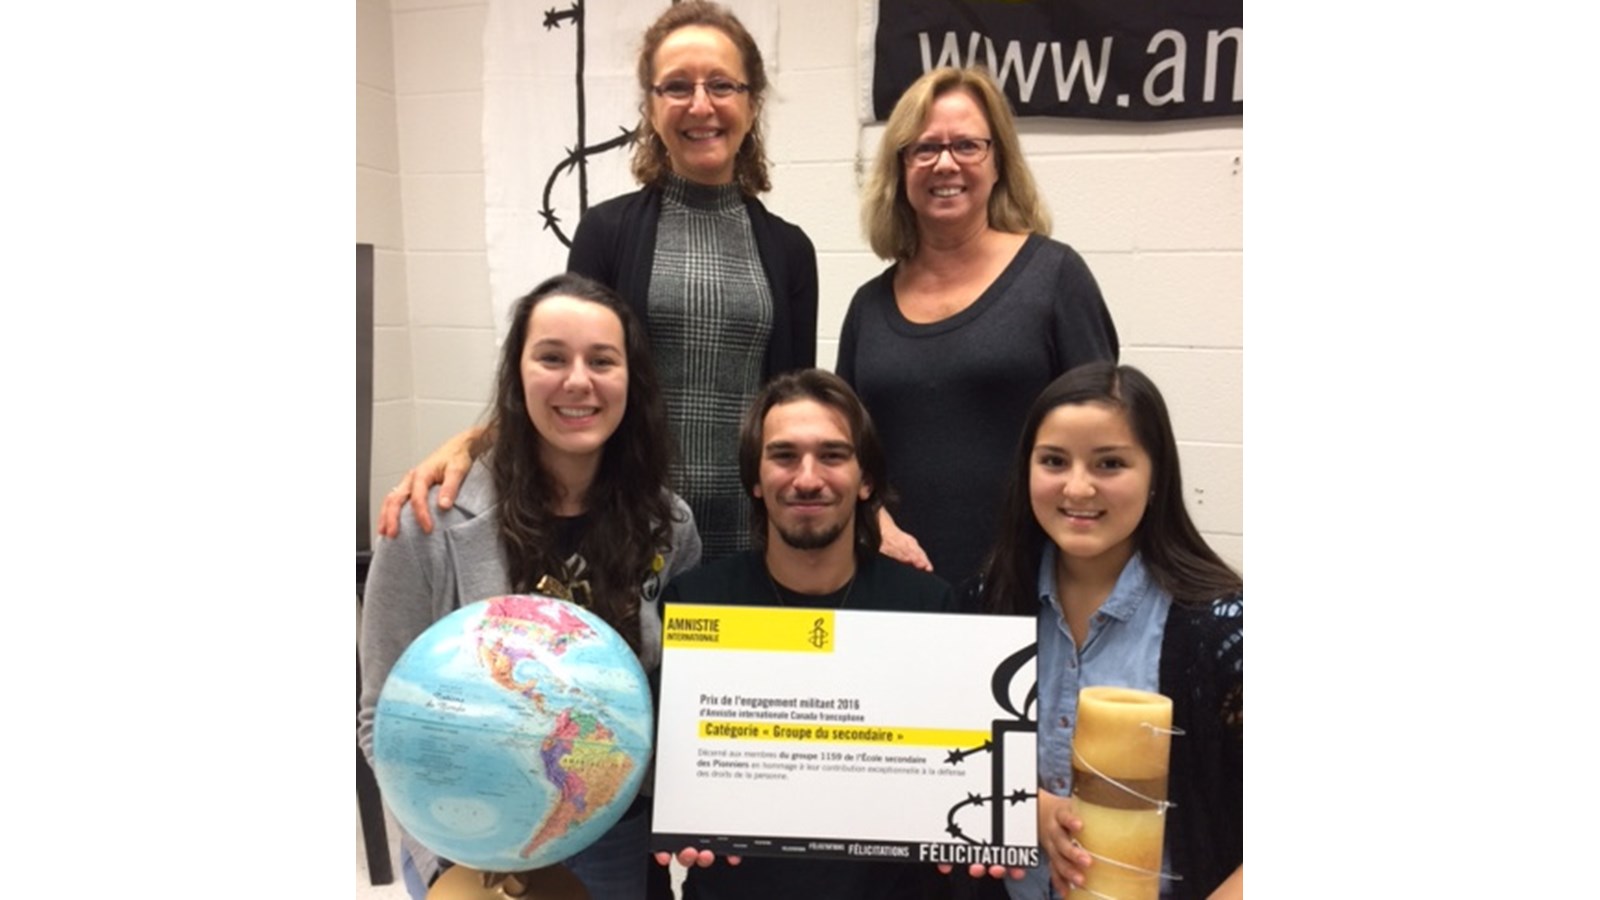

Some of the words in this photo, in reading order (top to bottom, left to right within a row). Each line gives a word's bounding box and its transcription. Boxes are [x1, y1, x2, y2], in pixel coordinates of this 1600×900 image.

[667, 618, 720, 633] AMNISTIE
[700, 694, 718, 706] Prix
[721, 696, 732, 706] de
[735, 696, 797, 709] l'engagement
[800, 698, 835, 710] militant
[837, 699, 860, 710] 2016
[739, 710, 788, 720] internationale
[790, 711, 818, 721] Canada
[820, 713, 865, 723] francophone
[705, 722, 759, 739] Catégorie
[773, 725, 812, 741] Groupe
[815, 727, 829, 740] du
[832, 728, 893, 742] secondaire
[744, 750, 777, 759] membres
[791, 752, 818, 761] groupe
[821, 752, 842, 761] 1159
[885, 754, 927, 763] secondaire
[713, 760, 749, 769] Pionniers
[763, 762, 798, 771] hommage
[807, 763, 820, 771] leur
[822, 763, 866, 773] contribution
[696, 770, 709, 778] des
[848, 843, 910, 857] FÉLICITATIONS
[920, 841, 1039, 867] FÉLICITATIONS
